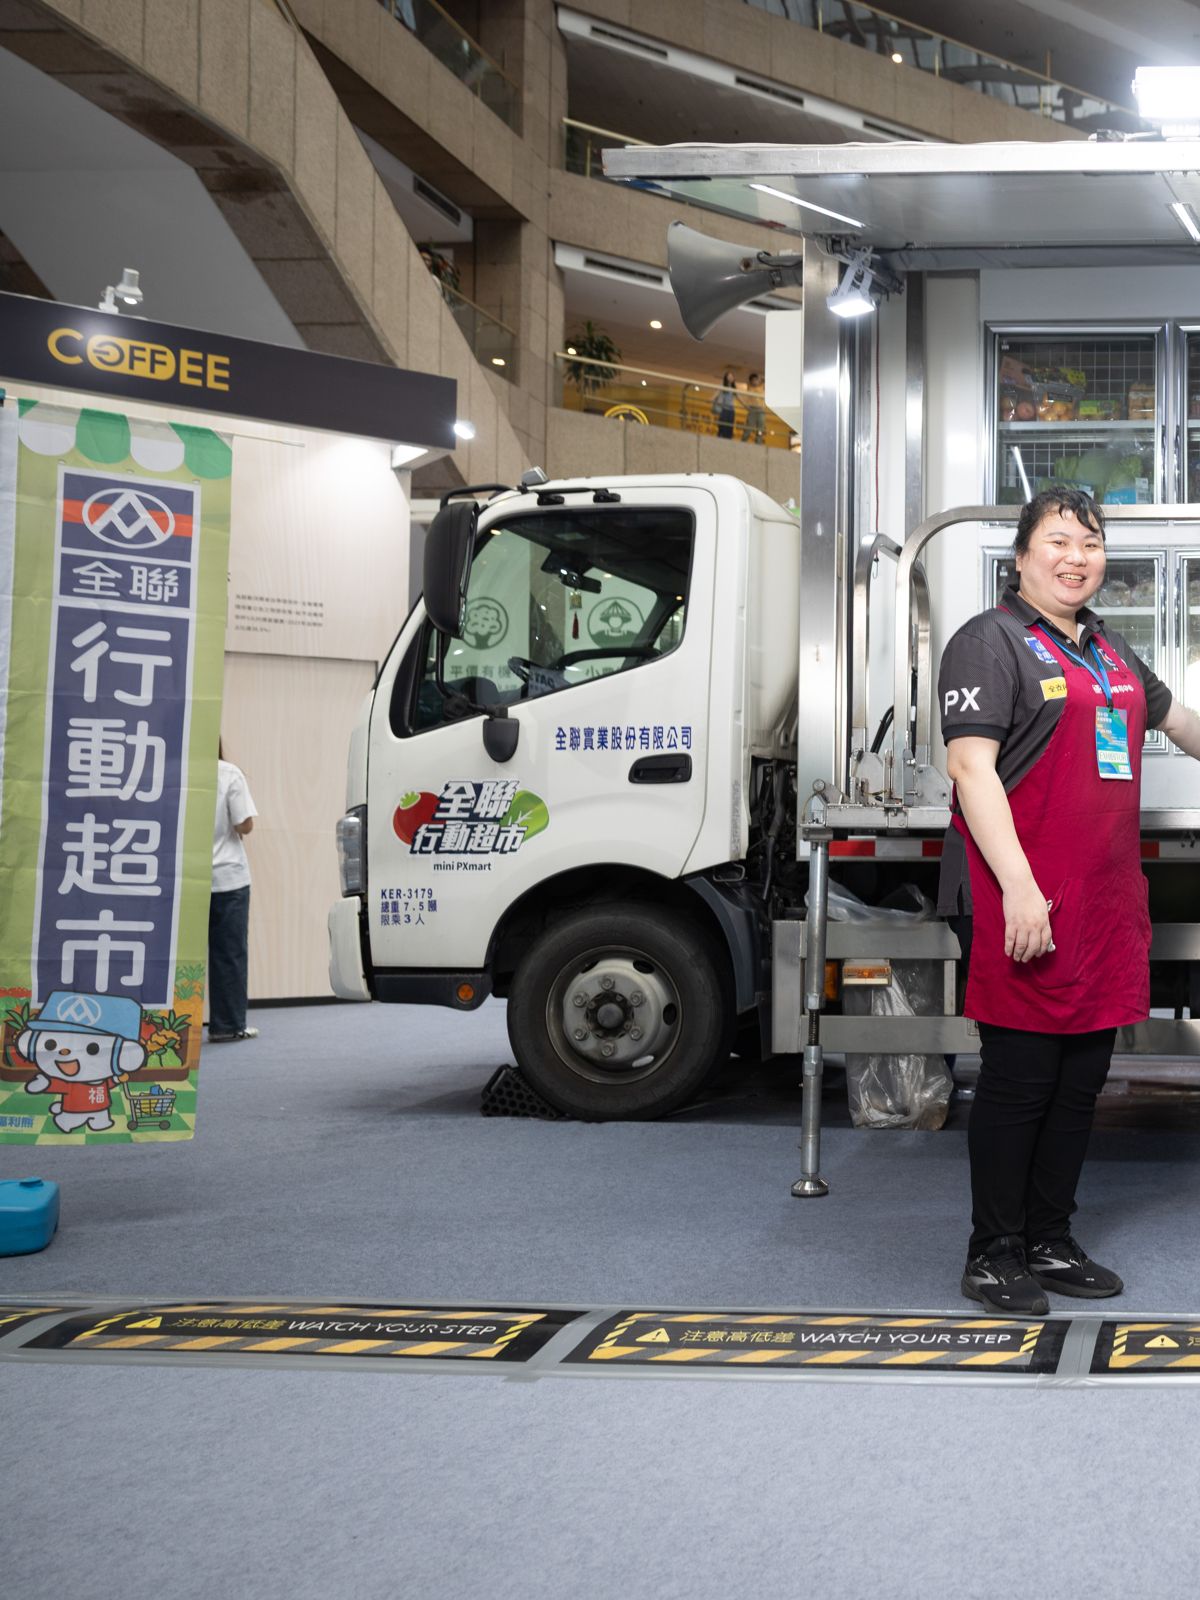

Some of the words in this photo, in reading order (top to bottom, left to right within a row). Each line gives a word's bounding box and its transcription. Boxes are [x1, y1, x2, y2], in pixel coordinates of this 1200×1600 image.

[47, 327, 231, 391] COFFEE
[72, 560, 179, 603] 全聯
[944, 687, 981, 716] PX
[555, 726, 692, 751] 全聯實業股份有限公司
[56, 620, 173, 993] 行動超市
[433, 780, 520, 819] 全聯
[410, 822, 529, 854] 行動超市
[433, 861, 455, 871] mini
[456, 861, 492, 871] PXmart
[381, 888, 433, 900] KER-3179
[88, 1086, 105, 1104] 福
[288, 1319, 367, 1333] WATCH
[374, 1322, 437, 1334] YOUR
[439, 1324, 498, 1336] STEP
[679, 1330, 797, 1344] 注意高低差
[801, 1332, 882, 1345] WATCH
[887, 1333, 952, 1344] YOUR
[956, 1334, 1012, 1345] STEP
